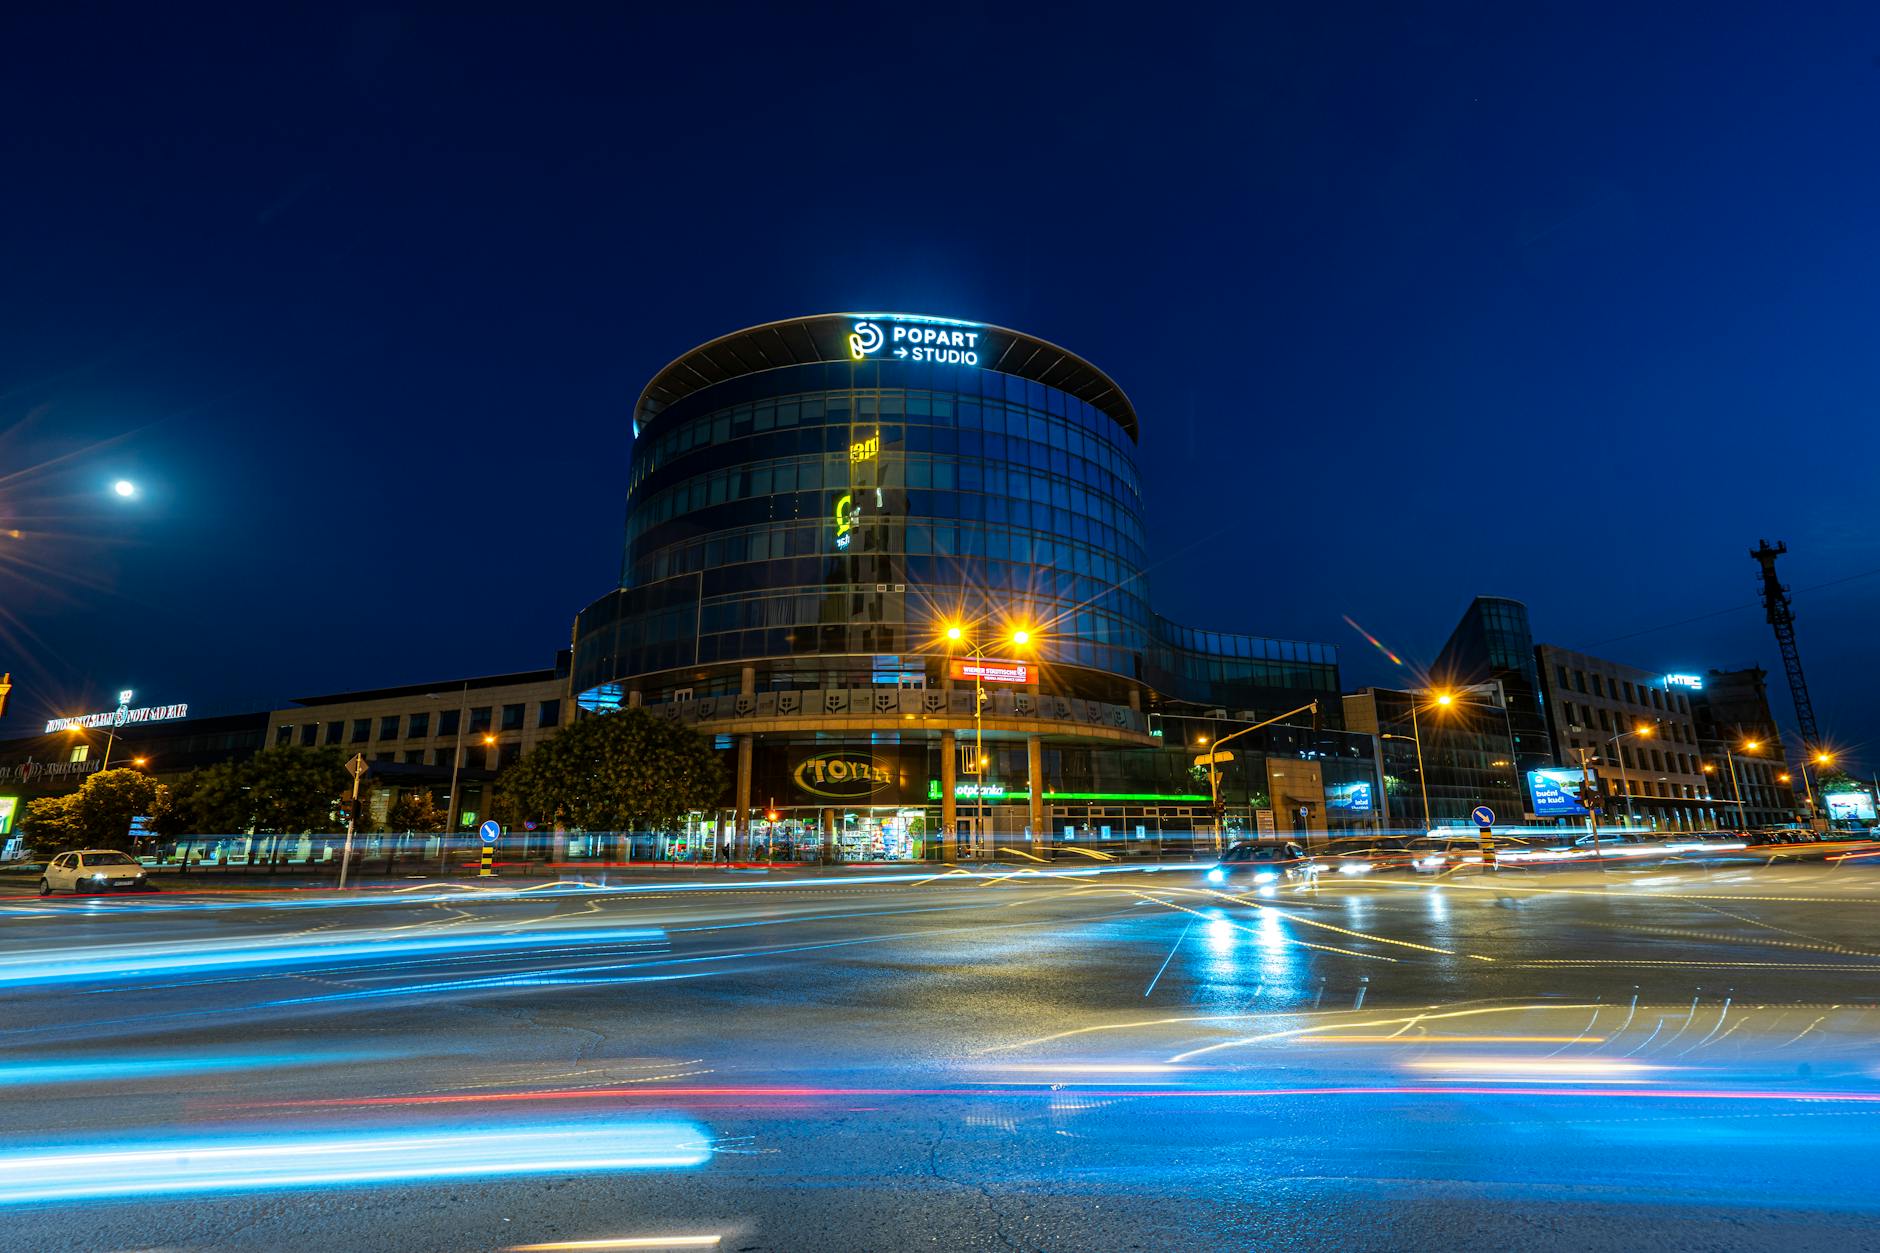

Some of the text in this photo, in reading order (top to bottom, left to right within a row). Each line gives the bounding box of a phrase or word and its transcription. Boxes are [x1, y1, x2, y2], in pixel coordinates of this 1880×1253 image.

[893, 326, 978, 348] POPART
[912, 347, 978, 365] STUDIO
[806, 758, 891, 786] TOYZZZ
